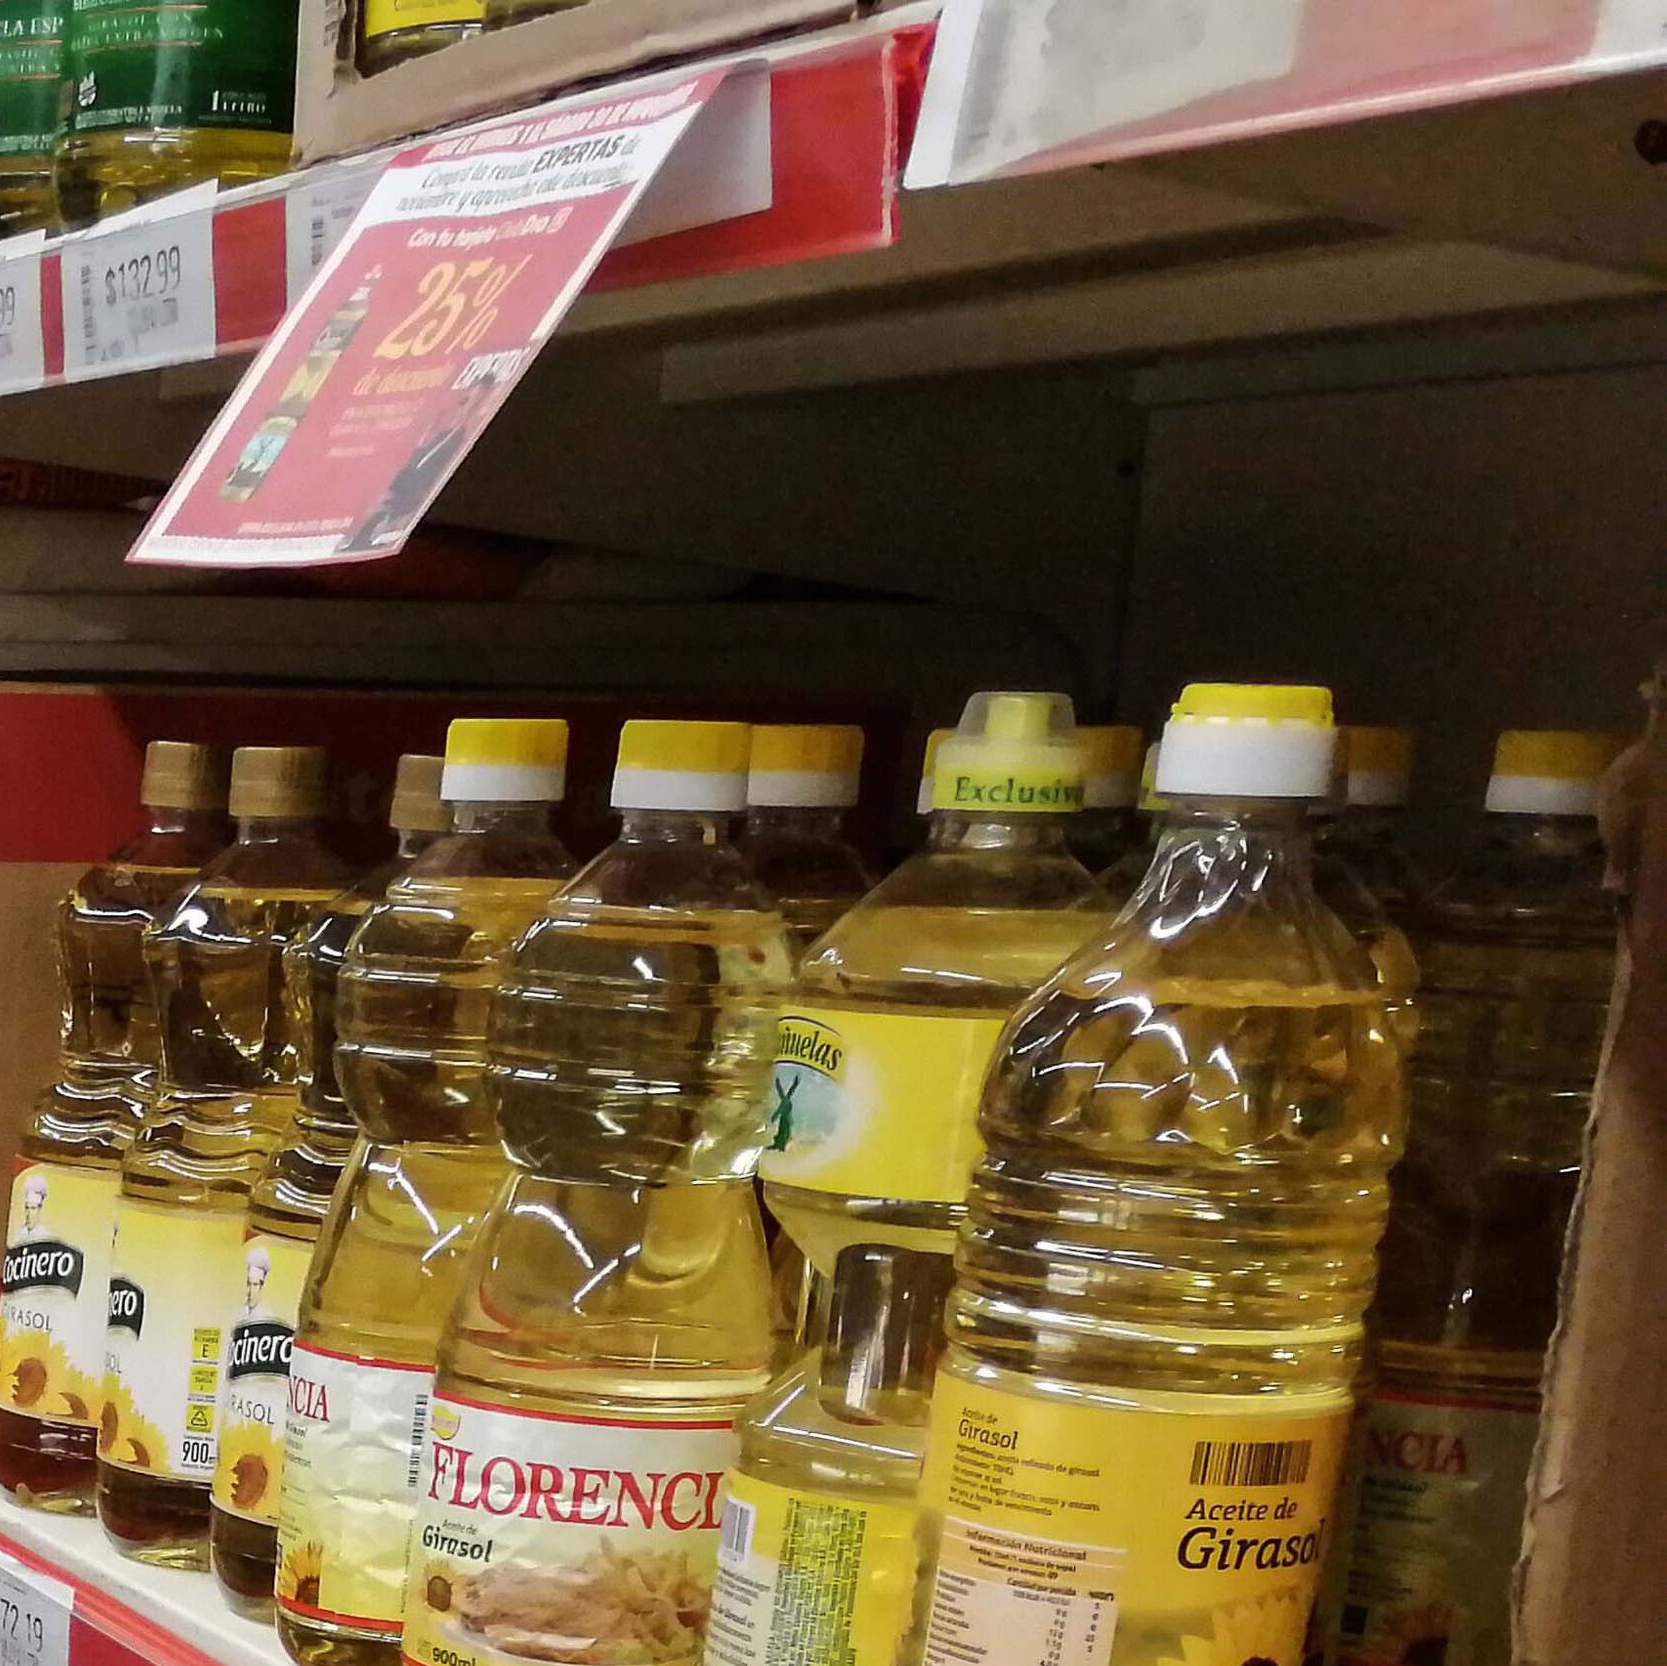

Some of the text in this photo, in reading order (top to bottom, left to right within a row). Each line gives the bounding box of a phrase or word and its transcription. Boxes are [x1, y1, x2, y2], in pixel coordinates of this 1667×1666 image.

[533, 135, 624, 174] EXPERTAS
[373, 254, 533, 359] 25%
[958, 1418, 1019, 1450] Girasol
[1185, 1497, 1297, 1521] Aceite de
[423, 1524, 493, 1563] Girasol
[1177, 1518, 1326, 1571] Girasol
